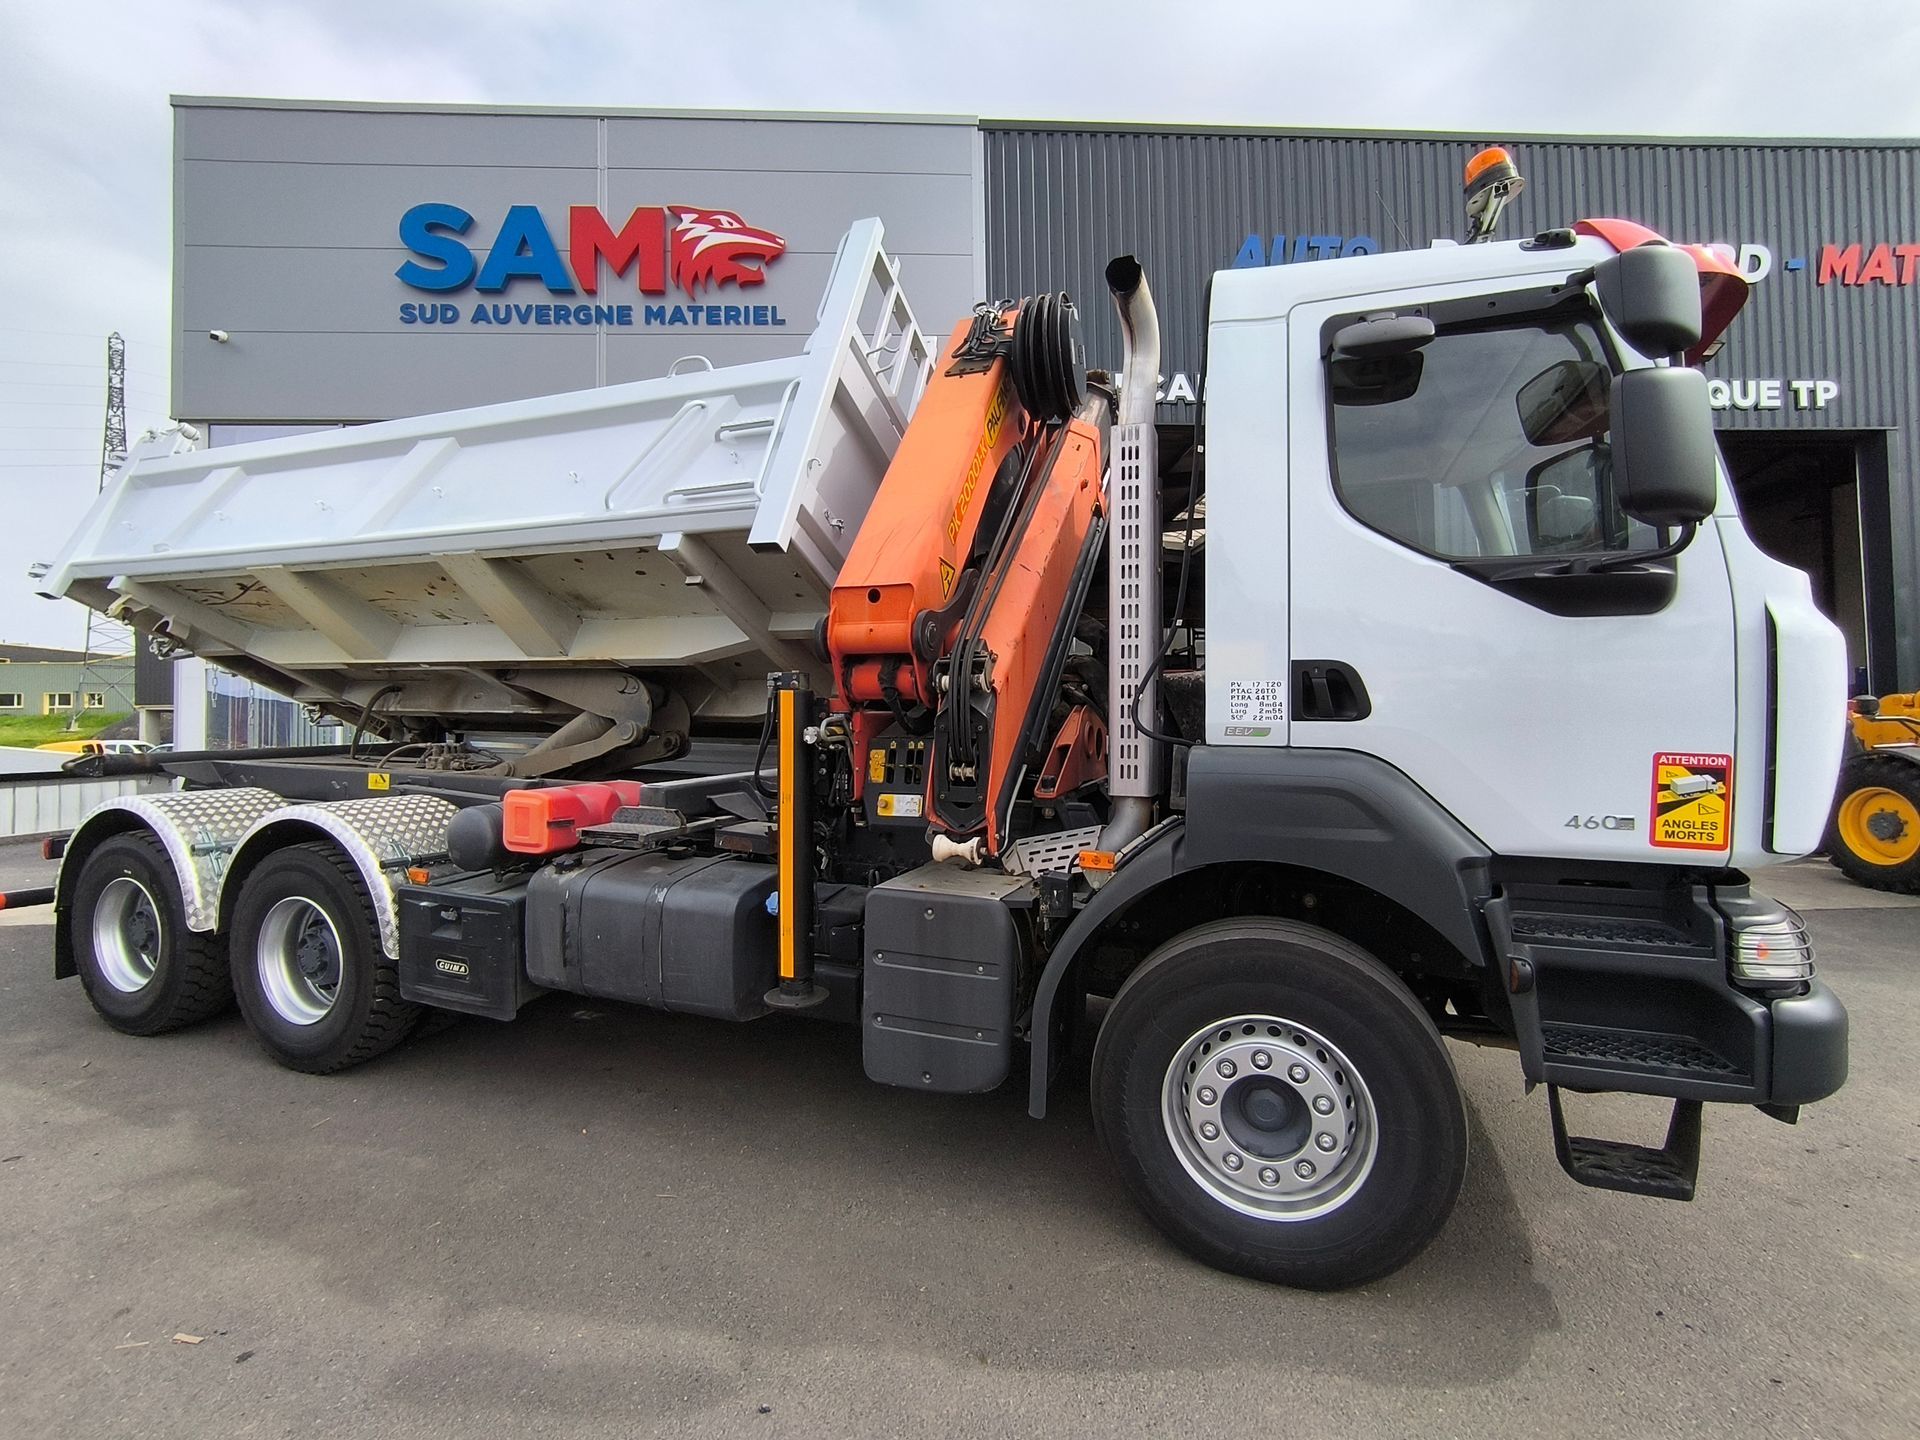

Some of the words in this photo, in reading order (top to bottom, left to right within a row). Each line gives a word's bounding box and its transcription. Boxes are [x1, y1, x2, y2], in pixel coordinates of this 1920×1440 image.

[394, 203, 666, 295] SAM
[399, 303, 459, 325] SUD
[471, 303, 633, 326] AUVERGNE
[644, 304, 786, 327] MATERIEL
[1790, 380, 1838, 409] TP
[948, 509, 960, 545] PK
[1226, 727, 1253, 735] EEV
[1658, 755, 1727, 766] ATTENTION
[1564, 815, 1618, 829] 460
[1662, 819, 1719, 831] ANGLES
[1664, 830, 1715, 842] MORTS
